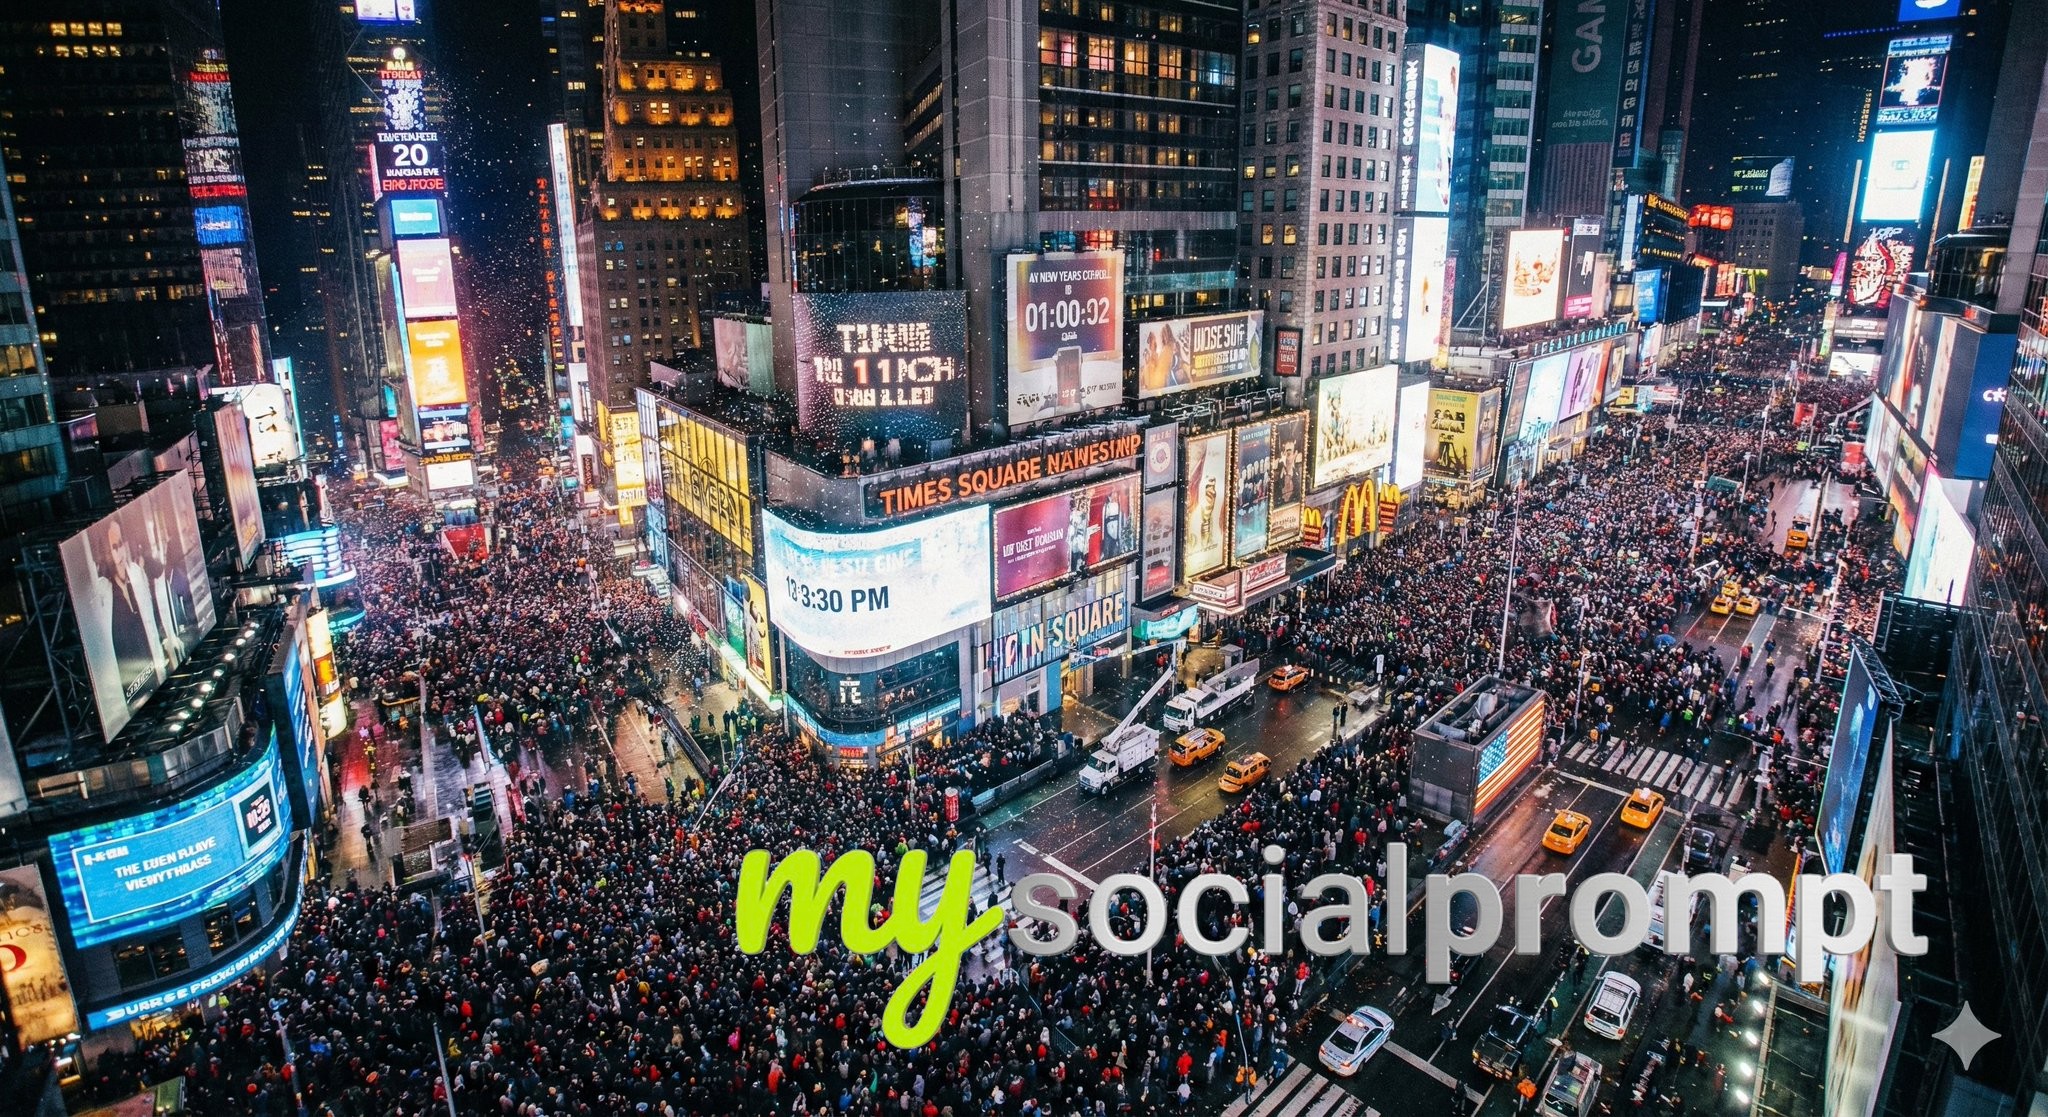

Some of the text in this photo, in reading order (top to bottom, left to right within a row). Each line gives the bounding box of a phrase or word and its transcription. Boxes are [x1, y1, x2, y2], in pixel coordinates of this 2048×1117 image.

[392, 143, 429, 167] 20
[1059, 270, 1081, 282] YEARS
[880, 478, 952, 515] TIMES
[958, 456, 1041, 497] SQUARE
[851, 585, 890, 613] PM
[1052, 590, 1126, 648] SQUARE
[114, 864, 142, 878] THE
